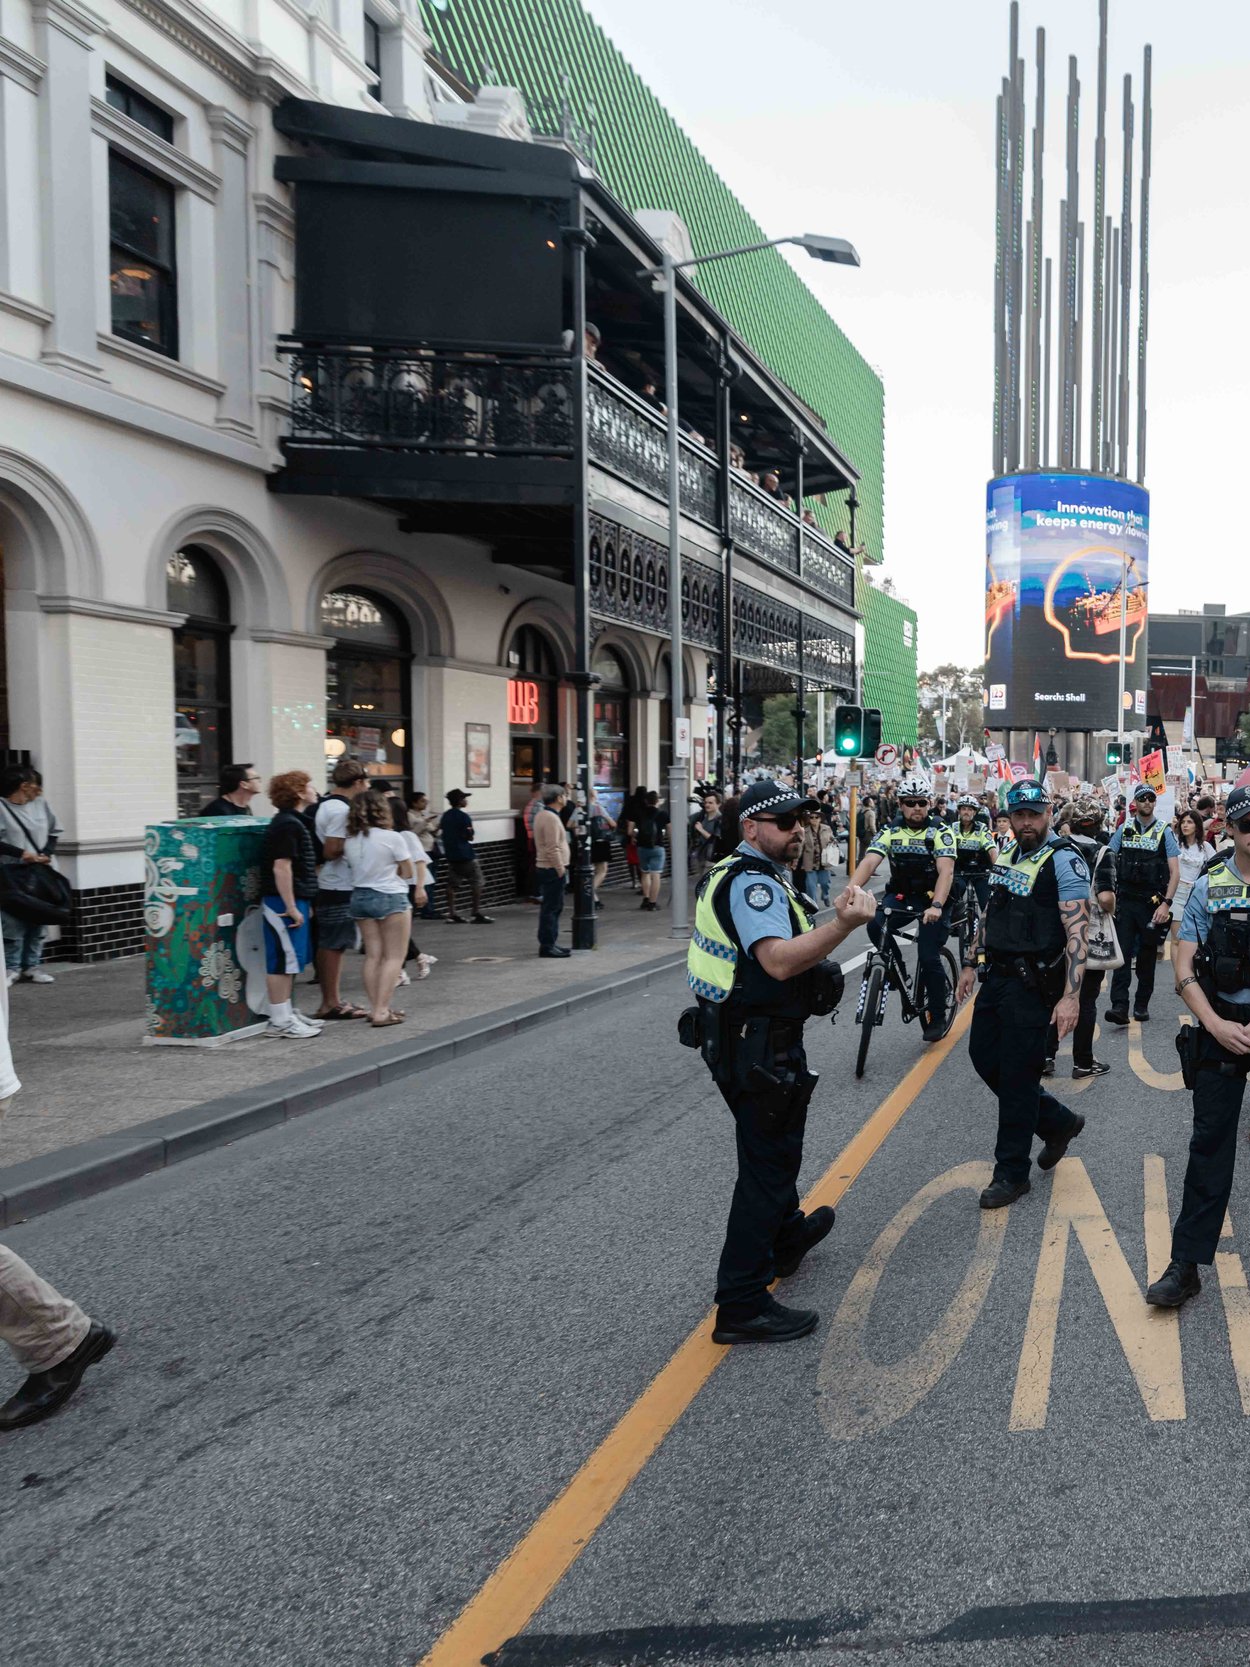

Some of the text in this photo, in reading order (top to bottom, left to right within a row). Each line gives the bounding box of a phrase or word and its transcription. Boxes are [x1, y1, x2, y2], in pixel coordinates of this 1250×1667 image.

[1057, 501, 1125, 519] Innovation
[1036, 514, 1077, 529] keeps
[1080, 519, 1123, 536] energy
[1034, 692, 1086, 702] Search: Shell
[1210, 886, 1240, 897] POLICE
